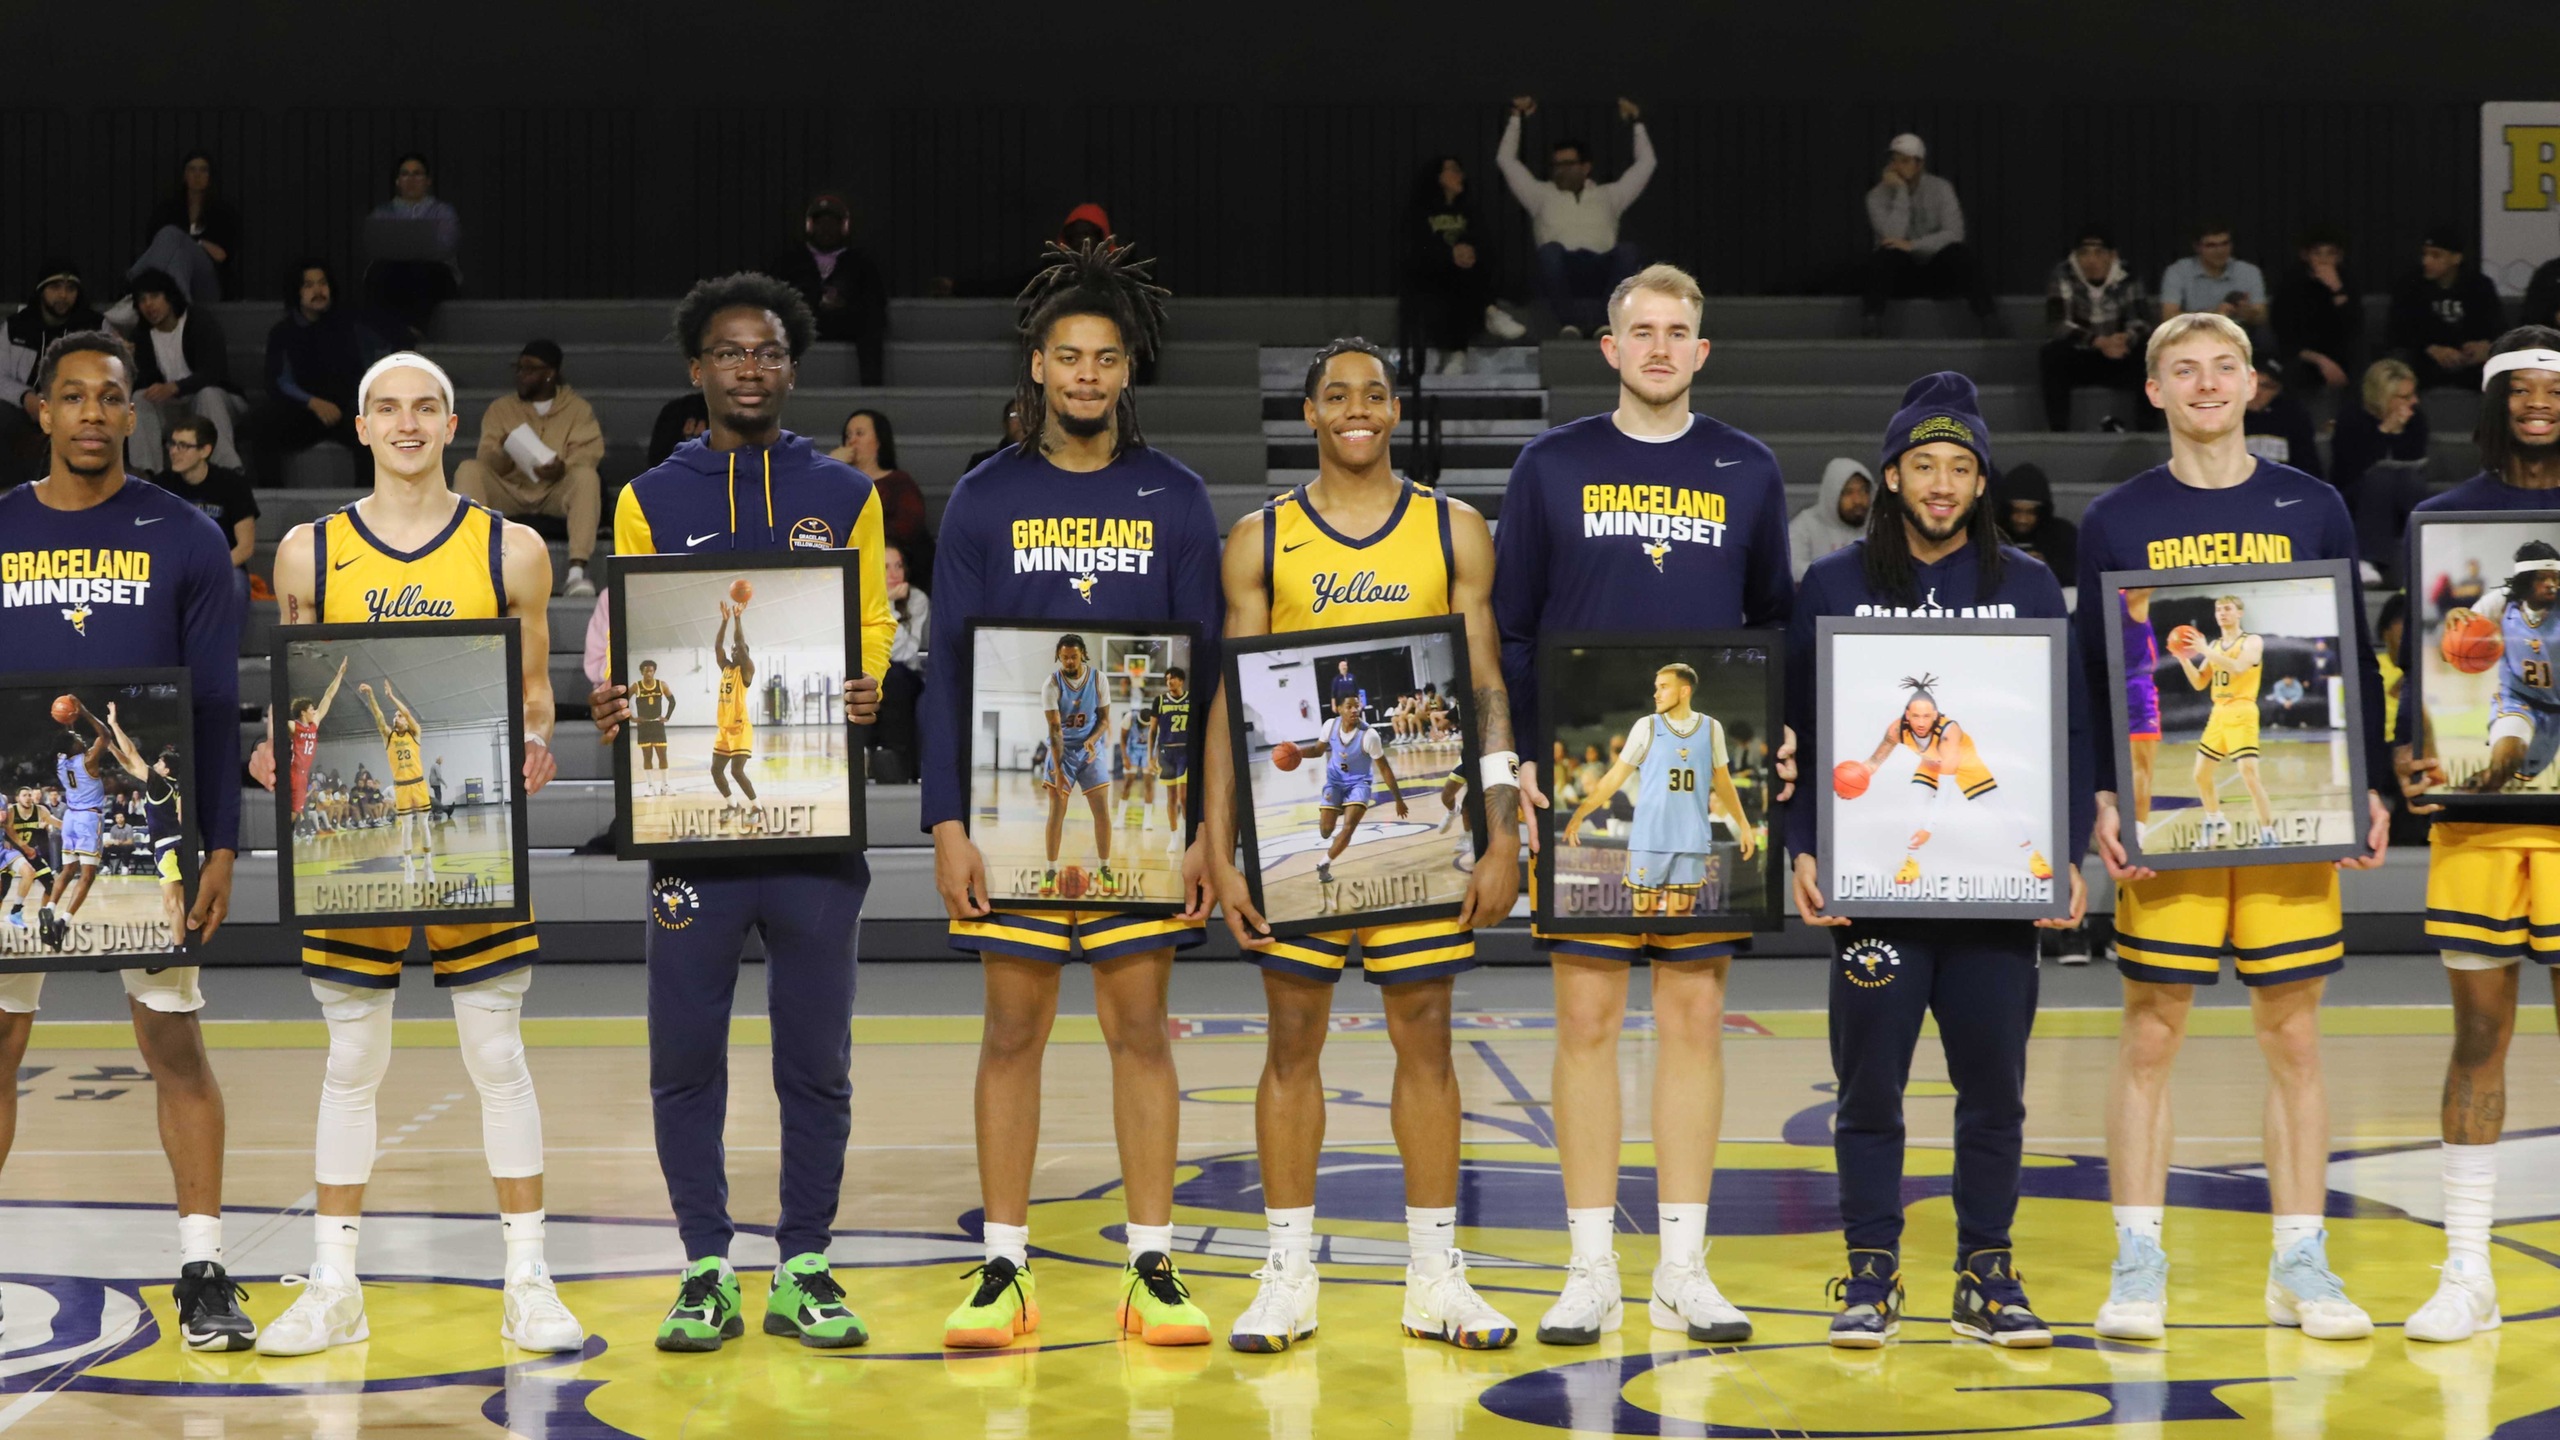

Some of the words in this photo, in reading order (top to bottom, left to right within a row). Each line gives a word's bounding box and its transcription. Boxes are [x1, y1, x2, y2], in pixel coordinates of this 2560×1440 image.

[1582, 484, 1726, 524] GRACELAND
[798, 533, 828, 542] GRACELAND
[1012, 517, 1154, 550] GRACELAND
[1583, 511, 1727, 547] MINDSET
[1, 549, 151, 583] GRACELAND
[1013, 547, 1154, 574] MINDSET
[2147, 532, 2292, 570] GRACELAND
[3, 578, 151, 608] MINDSET
[364, 584, 456, 623] Yellow
[1311, 570, 1411, 614] Yellow
[2523, 660, 2552, 688] 21
[396, 748, 412, 761] 23
[1668, 768, 1695, 792] 30
[313, 885, 402, 913] CARTER
[411, 877, 495, 909] BROWN
[652, 876, 700, 909] GRACELAND
[1349, 873, 1428, 909] SMITH
[1955, 872, 2052, 901] GILMORE
[100, 920, 172, 951] DAVIS
[1841, 938, 1901, 966] GRACELAND
